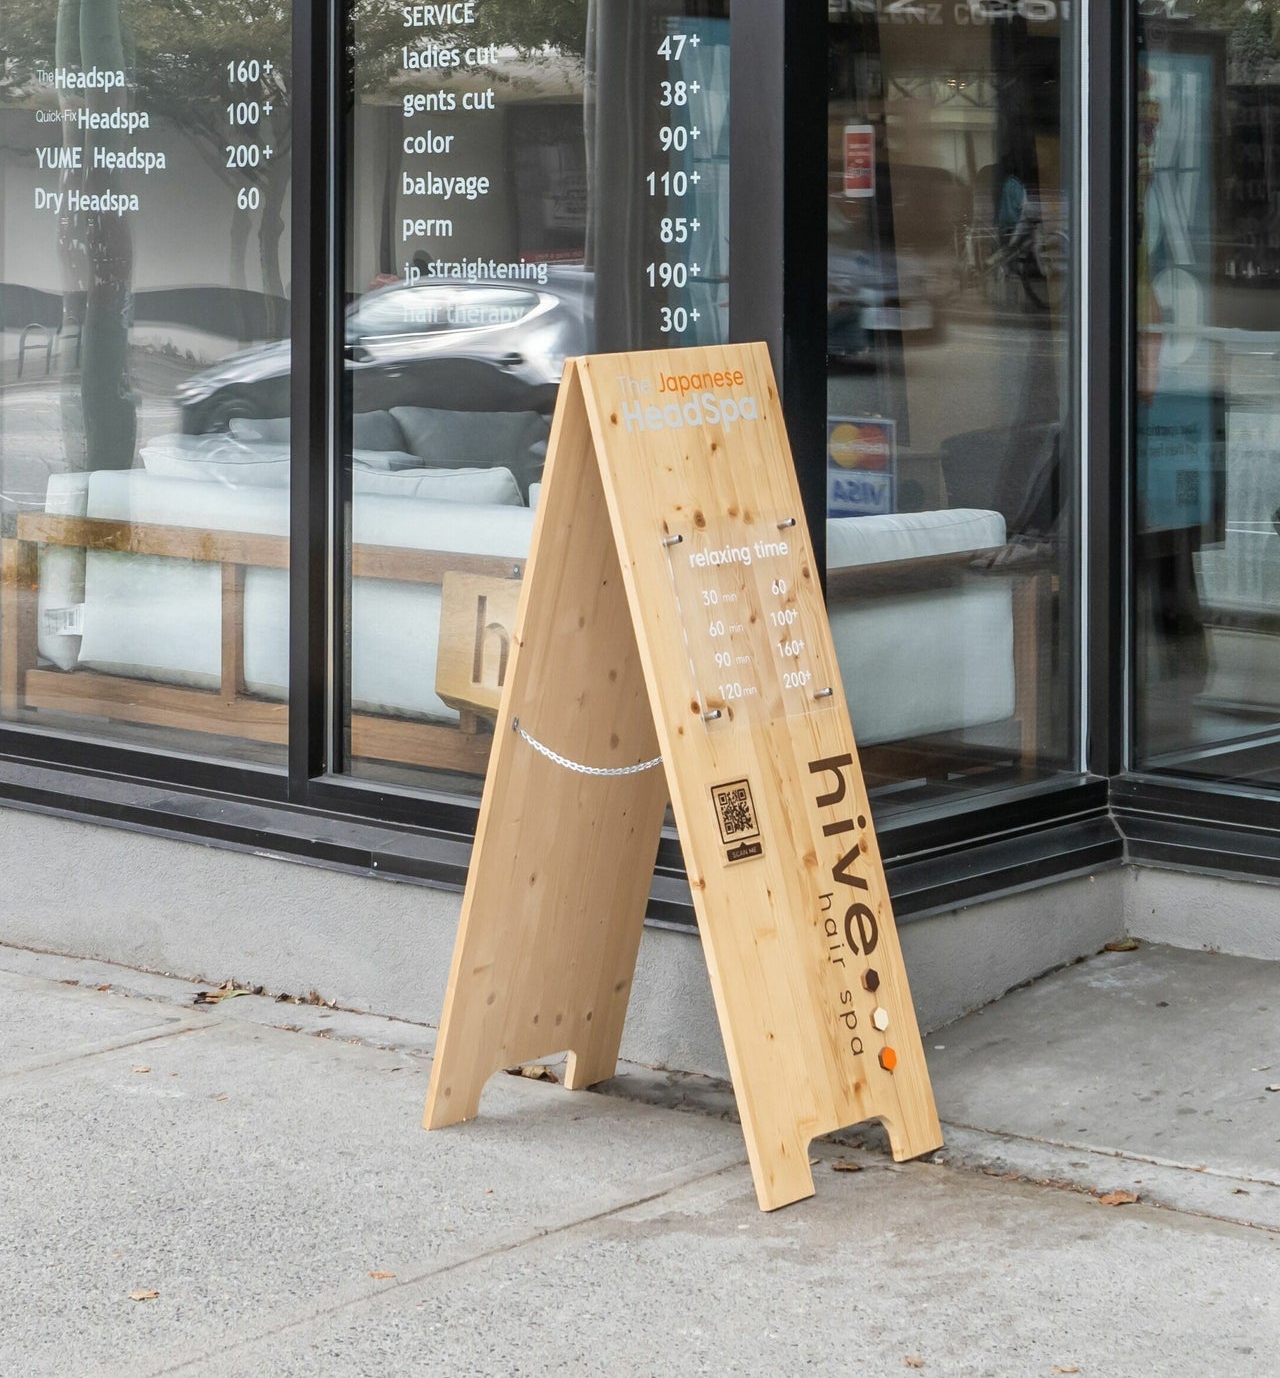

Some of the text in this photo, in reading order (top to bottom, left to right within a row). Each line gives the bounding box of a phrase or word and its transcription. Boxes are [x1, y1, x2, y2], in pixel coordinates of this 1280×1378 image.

[403, 2, 476, 27] SERVICE
[403, 33, 701, 70] ladies cut 47+
[37, 59, 273, 93] The Headspa 160+
[403, 80, 701, 118] gents cut 38+
[35, 100, 273, 134] Quick-Fix Headspa 100+
[403, 125, 701, 154] color 90+
[35, 144, 273, 175] YUME Headspa 200+
[402, 170, 701, 201] balayage 110+
[34, 187, 260, 216] Dry Headspa 60
[402, 217, 701, 243] perm 85+
[403, 258, 701, 288] jp straightening 190+
[660, 307, 701, 333] 30+
[616, 370, 744, 398] The Japanese
[622, 391, 758, 434] HeadSpa
[689, 540, 788, 567] relaxing time
[702, 579, 787, 606] 30 min 60
[709, 609, 799, 637] 60 min 100+
[715, 639, 805, 669] 90 min 160+
[718, 670, 812, 700] 120 min 200+
[808, 752, 879, 957] hive
[818, 892, 864, 1056] hair spa
